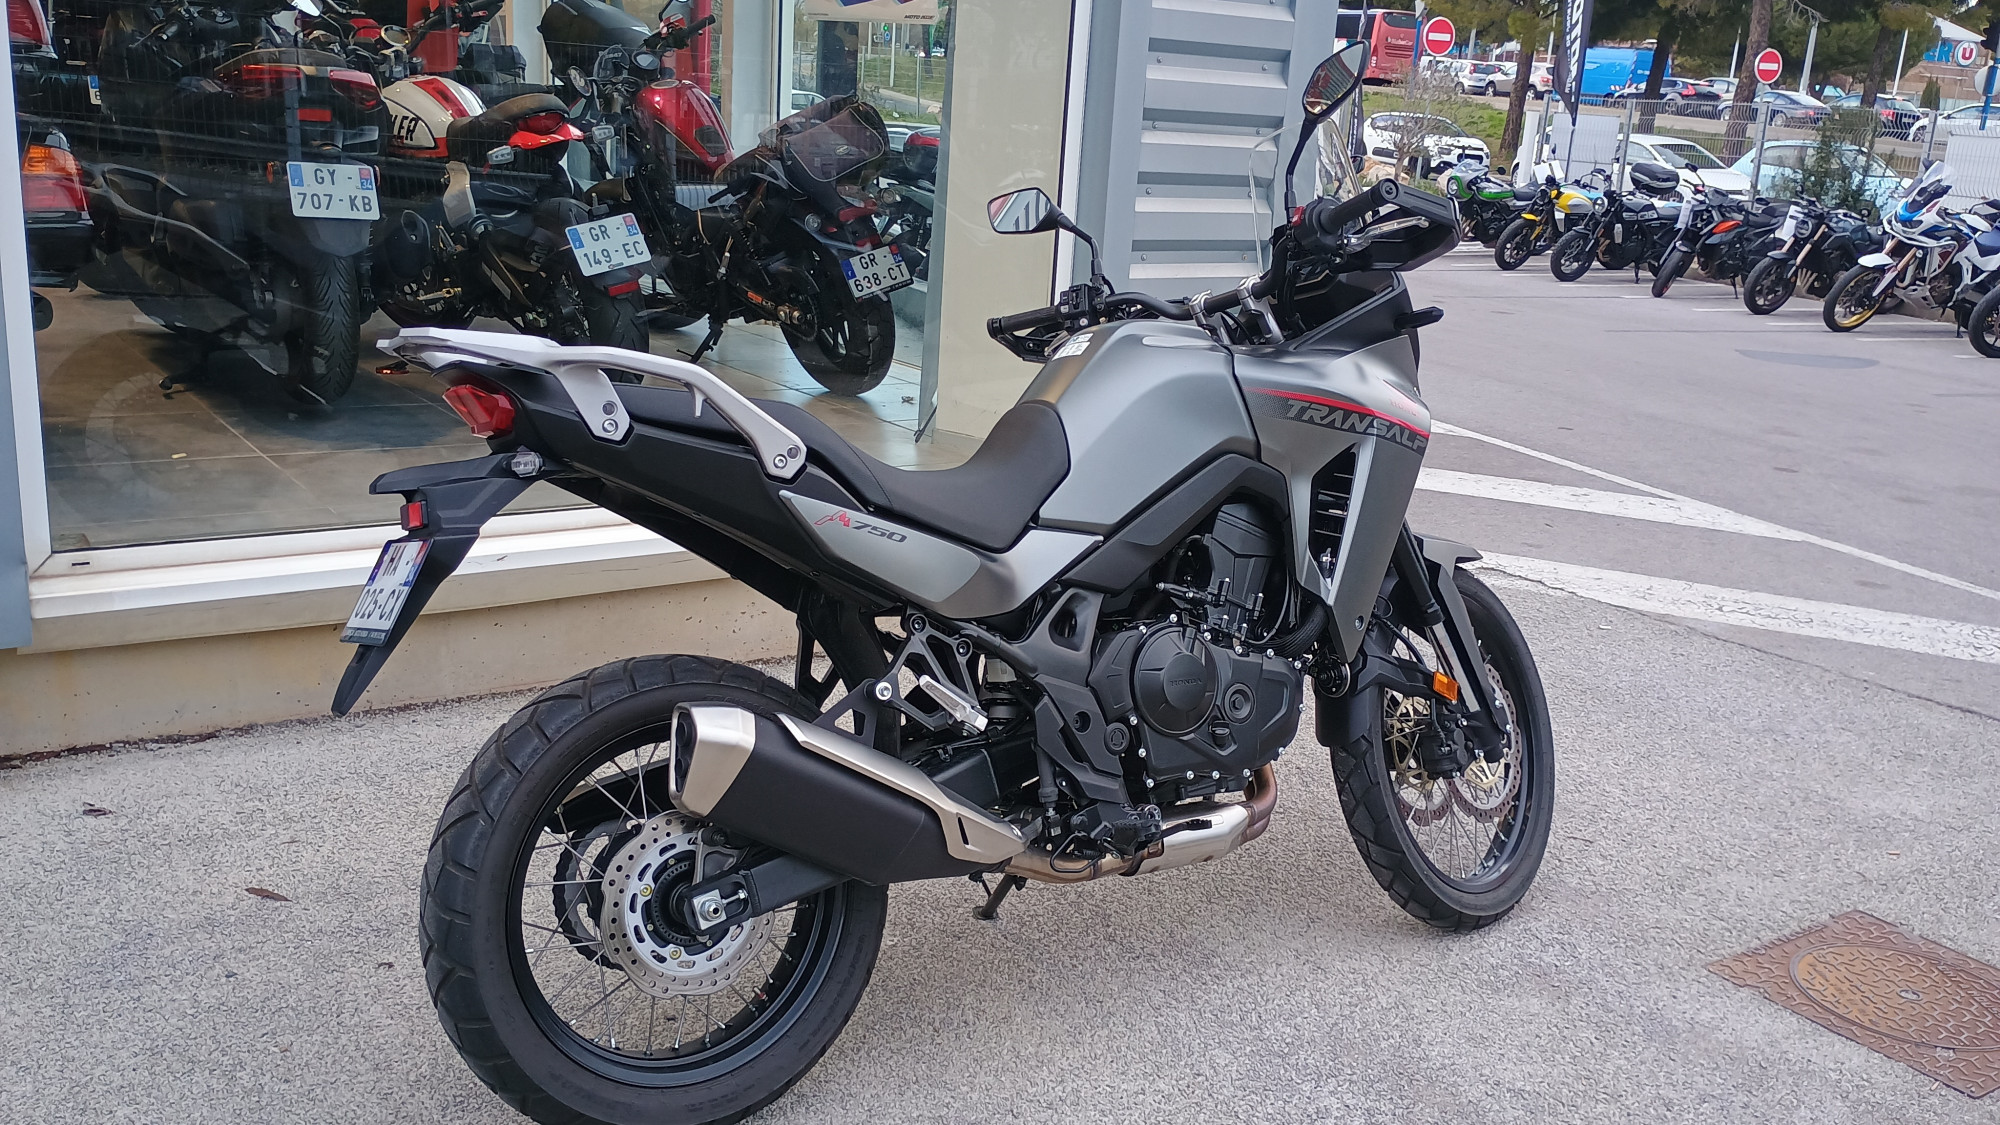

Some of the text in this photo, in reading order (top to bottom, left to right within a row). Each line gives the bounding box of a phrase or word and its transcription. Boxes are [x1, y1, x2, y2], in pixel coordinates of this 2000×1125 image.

[1961, 47, 1974, 60] U
[314, 168, 336, 186] GY
[361, 179, 372, 189] 34
[297, 192, 373, 213] 707-KB
[588, 224, 611, 242] GR
[627, 225, 638, 235] 34
[583, 240, 644, 268] 149-EC
[859, 252, 878, 270] GR
[853, 263, 905, 293] 638-CT
[1286, 399, 1427, 451] TRANSALP
[852, 520, 908, 543] 750
[382, 545, 407, 577] HA
[354, 588, 405, 621] 025-CX
